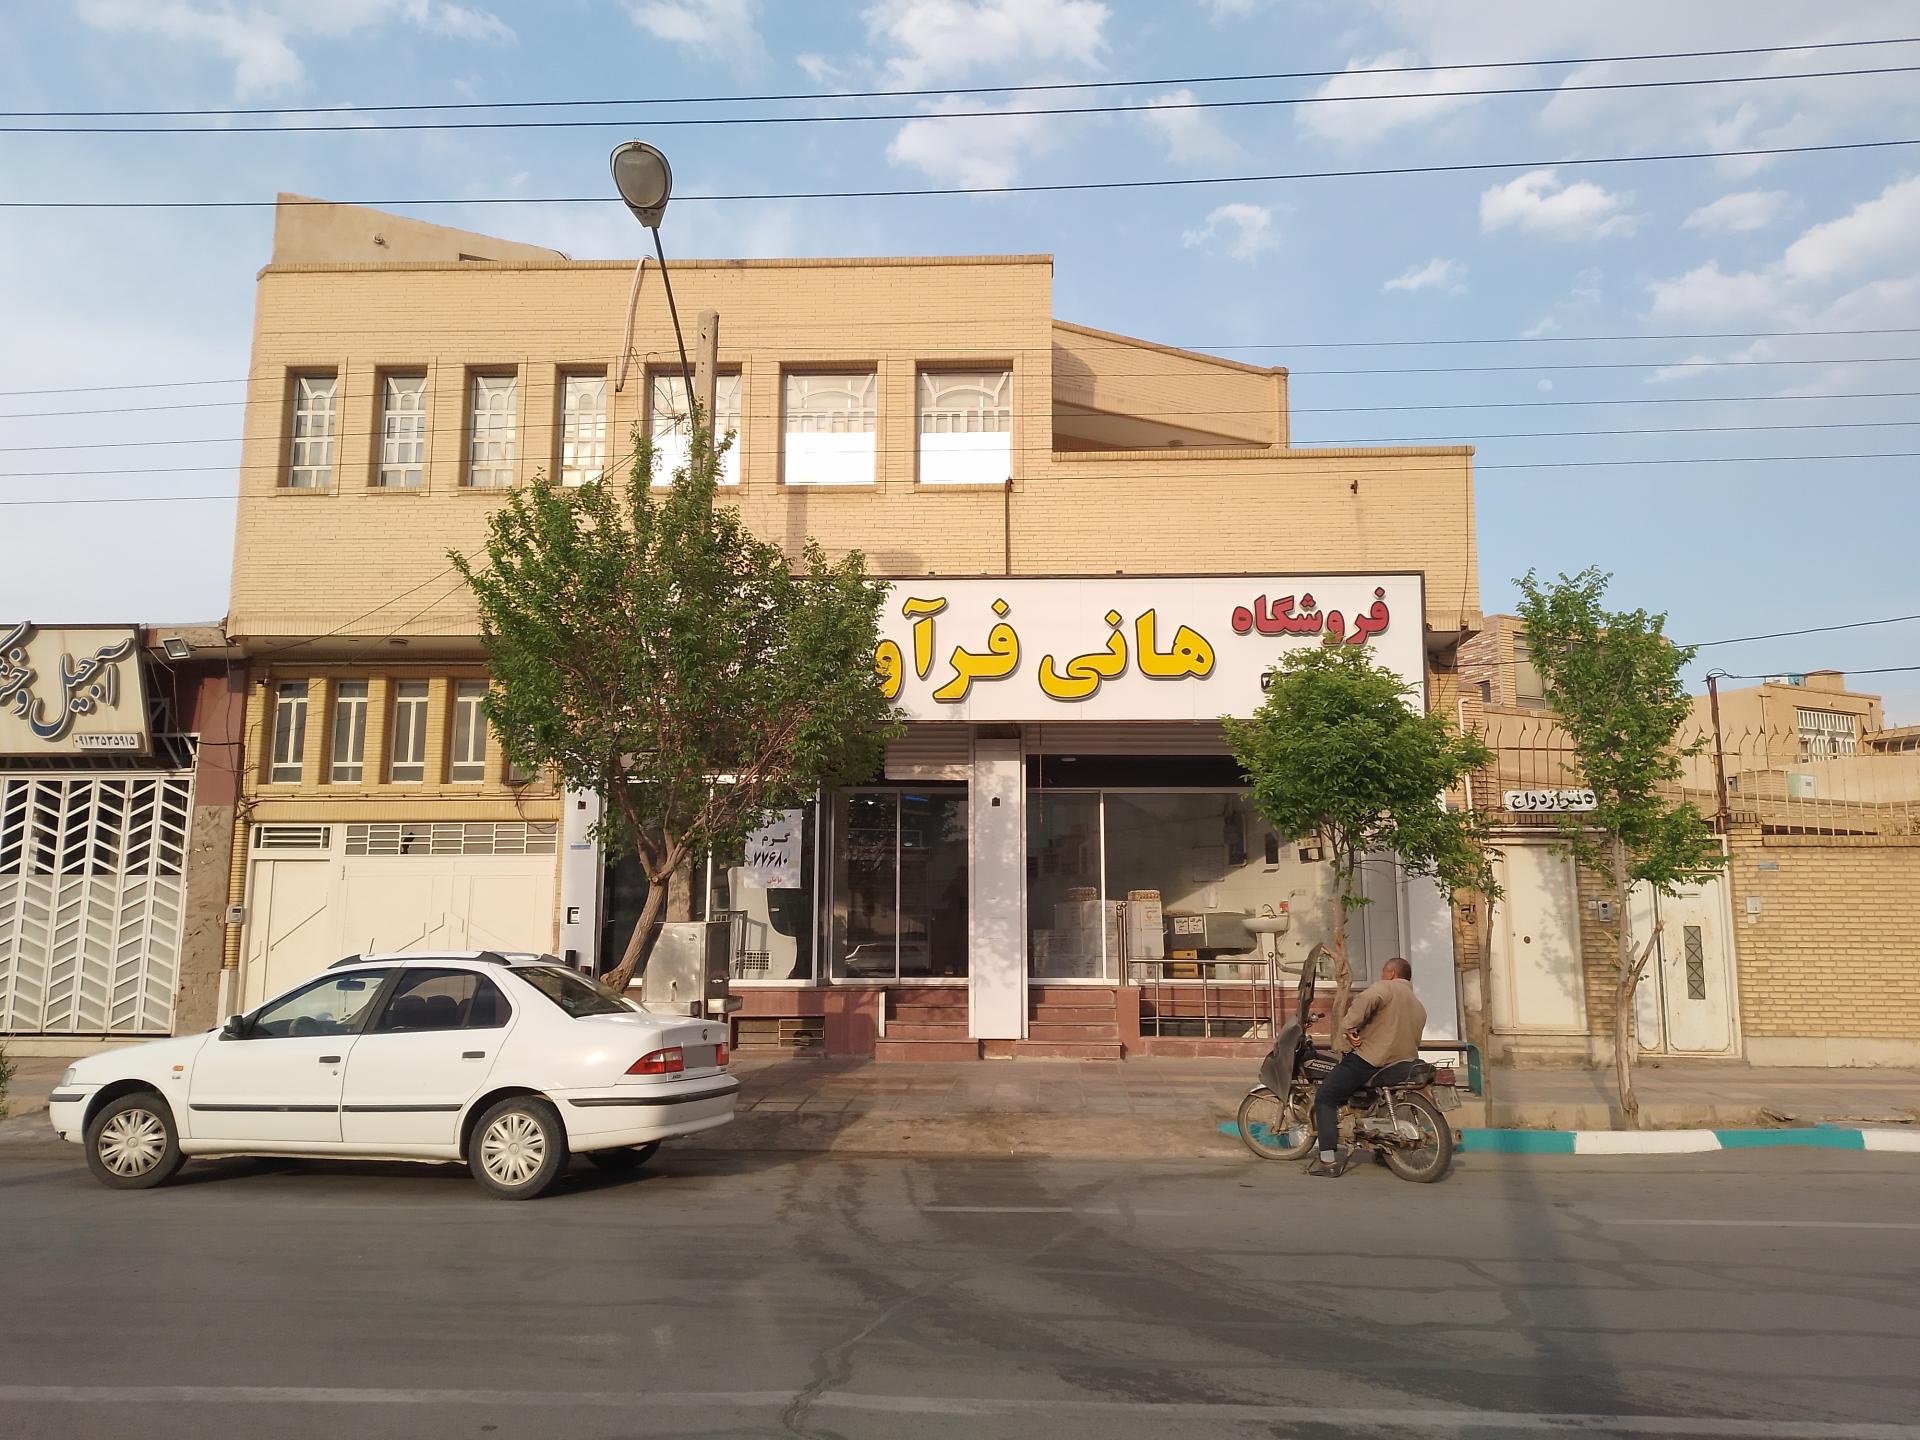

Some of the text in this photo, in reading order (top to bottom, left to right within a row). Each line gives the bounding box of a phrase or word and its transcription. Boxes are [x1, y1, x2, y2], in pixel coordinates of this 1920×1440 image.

[1038, 608, 1216, 701] هانی
[1231, 586, 1390, 645] فروشگاه
[29, 638, 133, 739] آجیل
